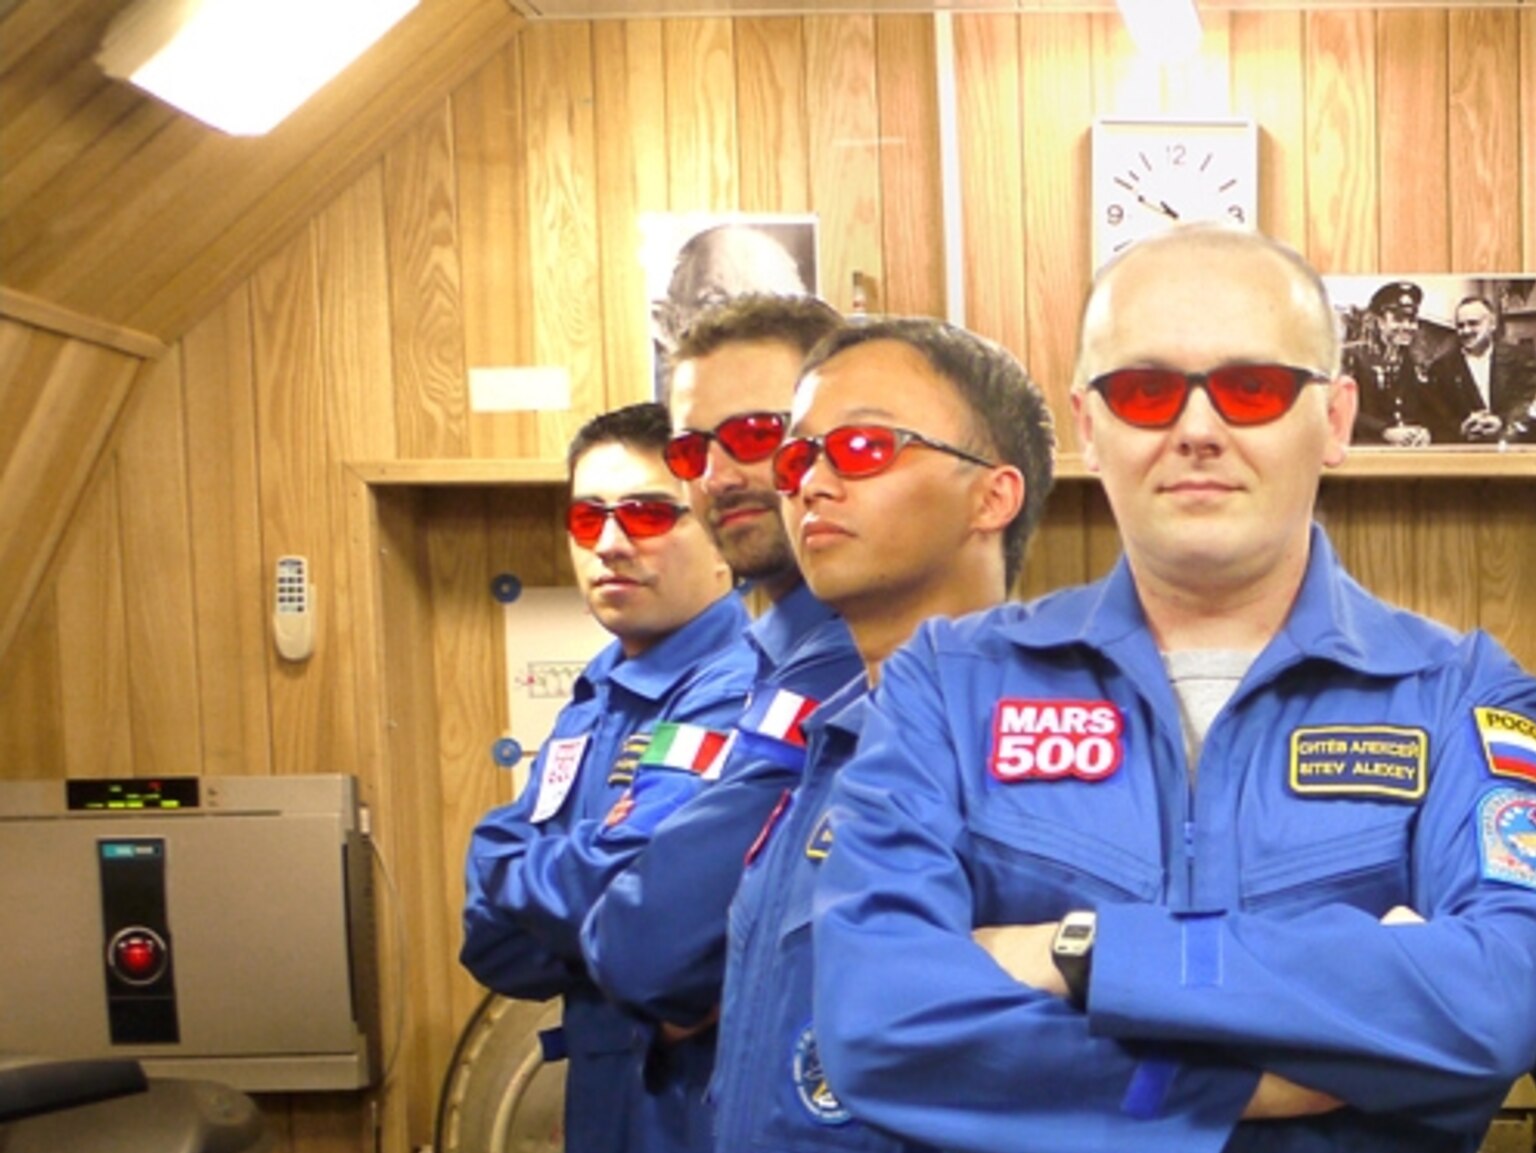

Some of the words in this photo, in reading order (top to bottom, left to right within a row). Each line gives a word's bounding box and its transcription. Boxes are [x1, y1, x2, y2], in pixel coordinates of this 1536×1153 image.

[1166, 145, 1187, 166] 12
[1107, 204, 1124, 226] 9
[1001, 705, 1117, 735] MARS
[996, 735, 1115, 777] 500
[1352, 762, 1416, 780] ALEXEY
